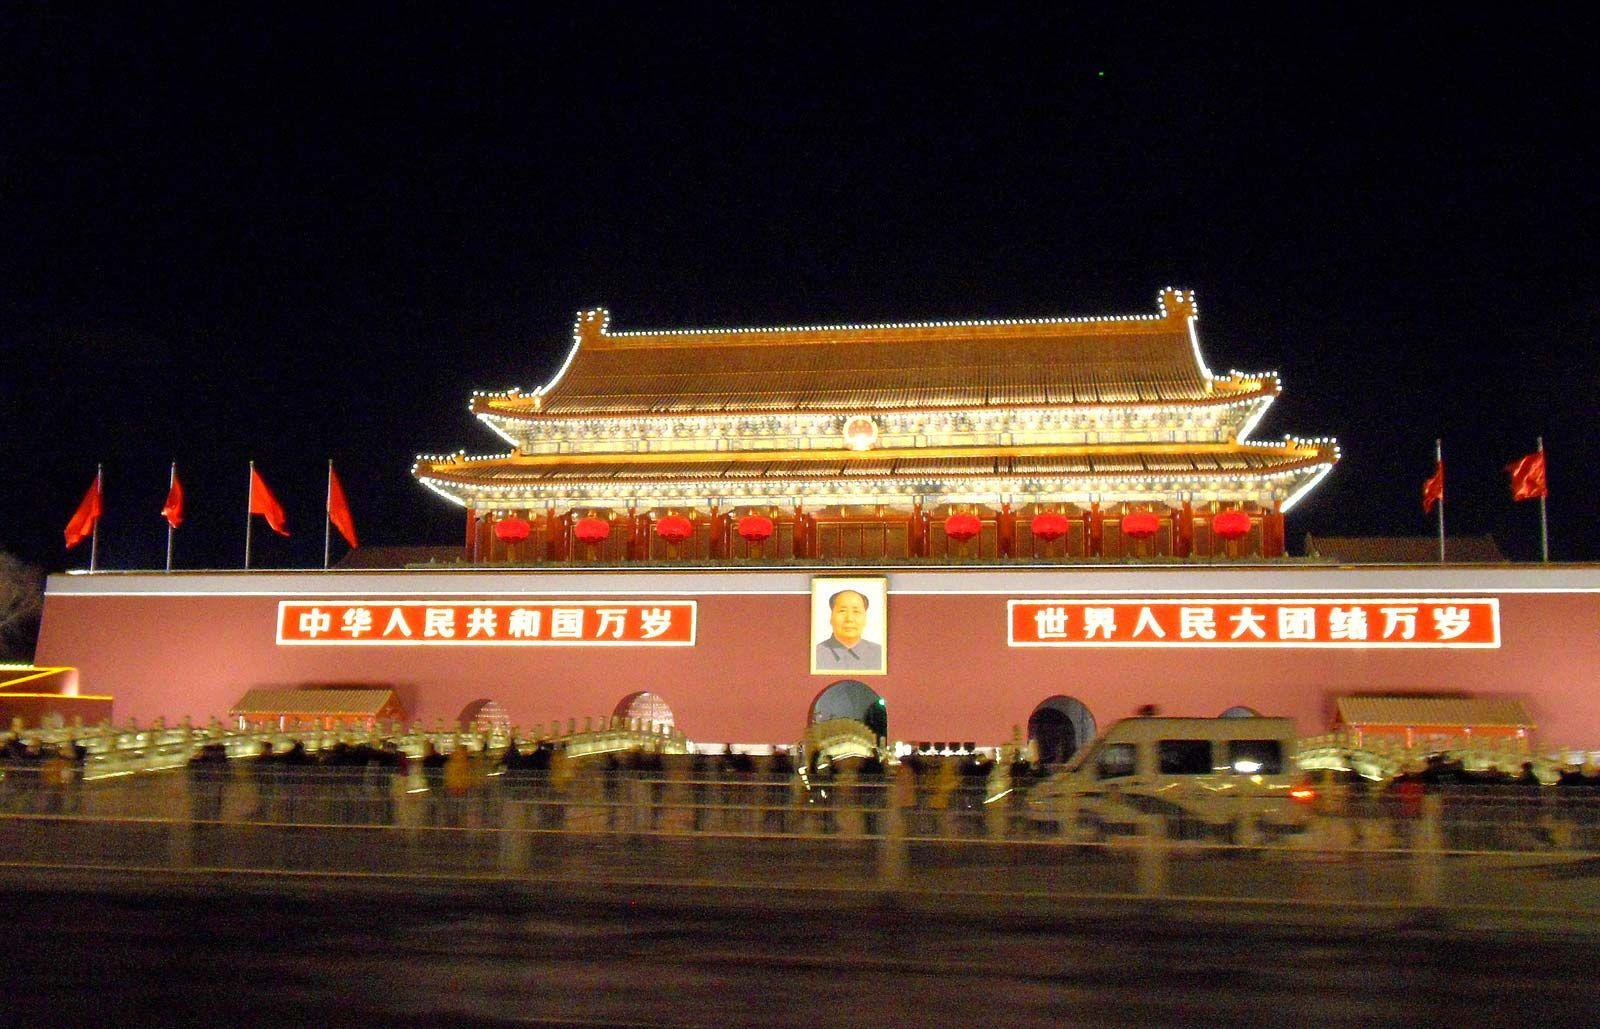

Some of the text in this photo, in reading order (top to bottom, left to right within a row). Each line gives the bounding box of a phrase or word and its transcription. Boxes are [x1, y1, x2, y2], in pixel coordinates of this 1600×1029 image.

[299, 607, 671, 638] 中华人民共和国万岁
[1035, 607, 1469, 639] 世界人民大团结万岁
